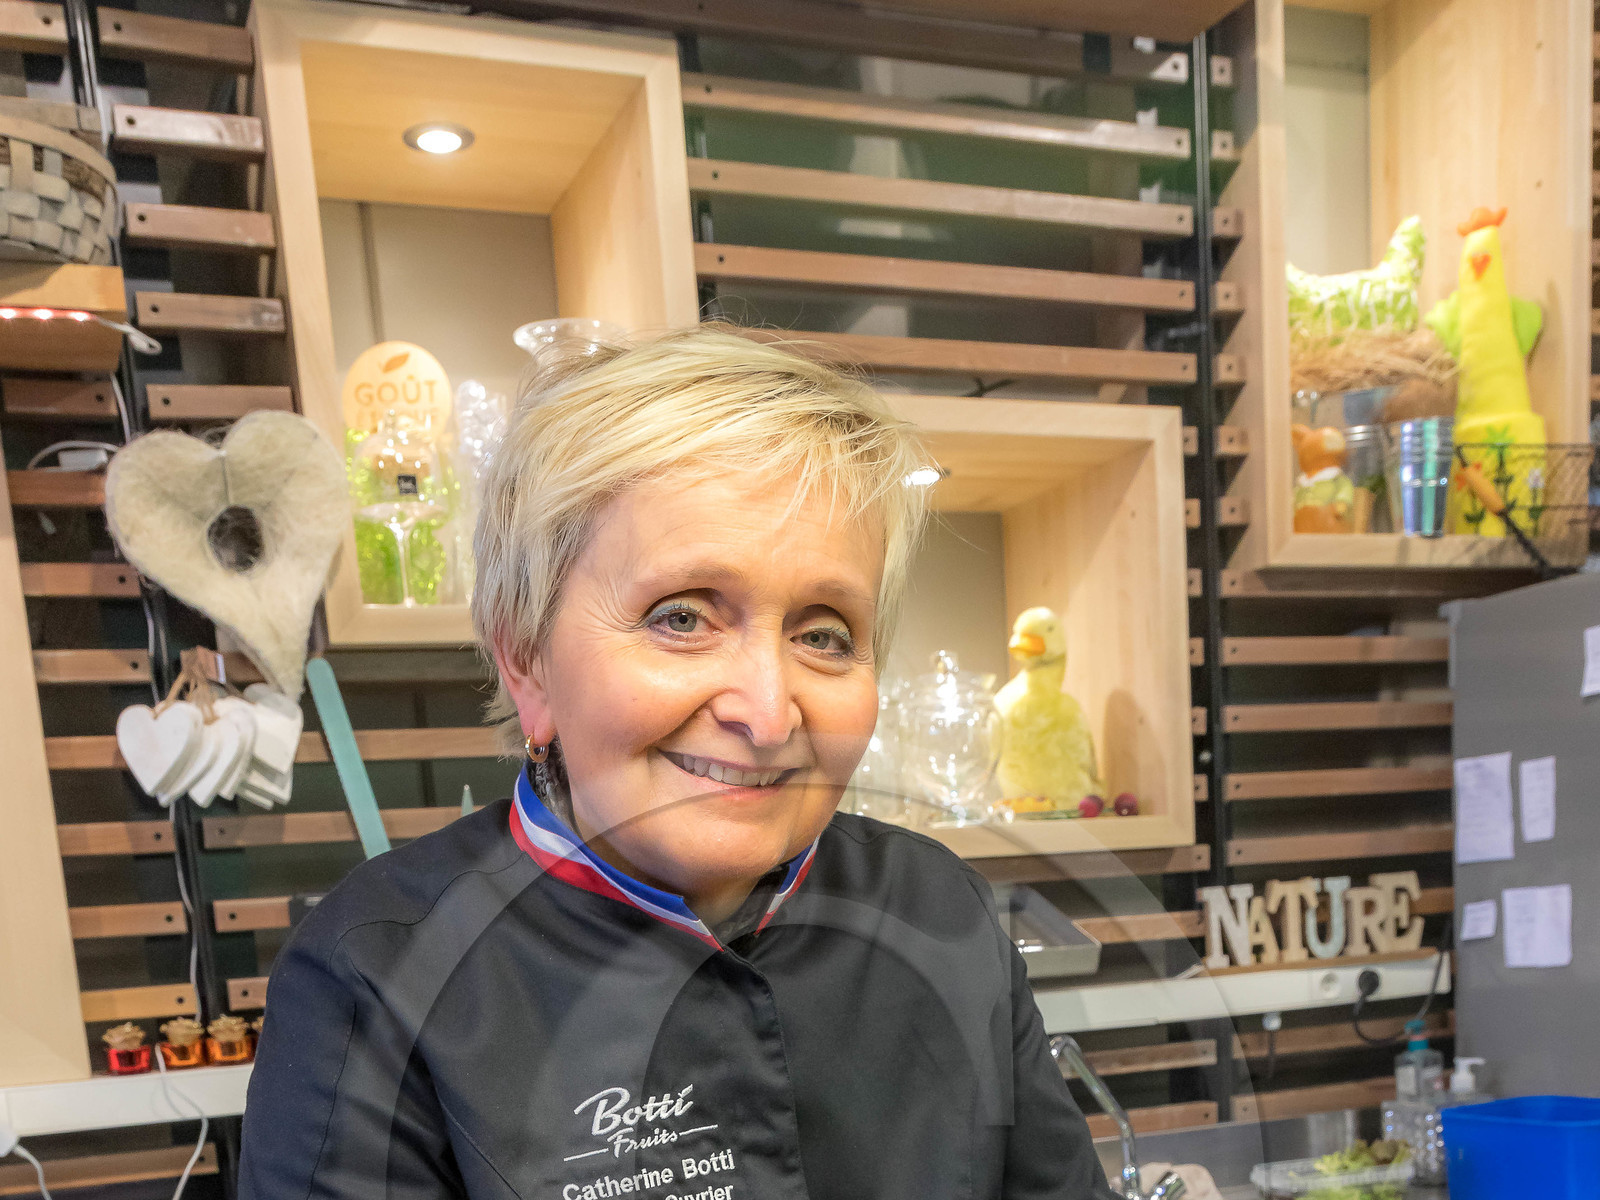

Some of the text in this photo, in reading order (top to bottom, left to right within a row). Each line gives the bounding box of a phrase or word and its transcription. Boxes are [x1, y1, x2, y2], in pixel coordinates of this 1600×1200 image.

[355, 375, 437, 406] GOÛT
[1199, 871, 1425, 969] NATURE
[574, 1084, 693, 1136] Botti
[607, 1127, 678, 1158] Fruits
[681, 1148, 736, 1180] Botti
